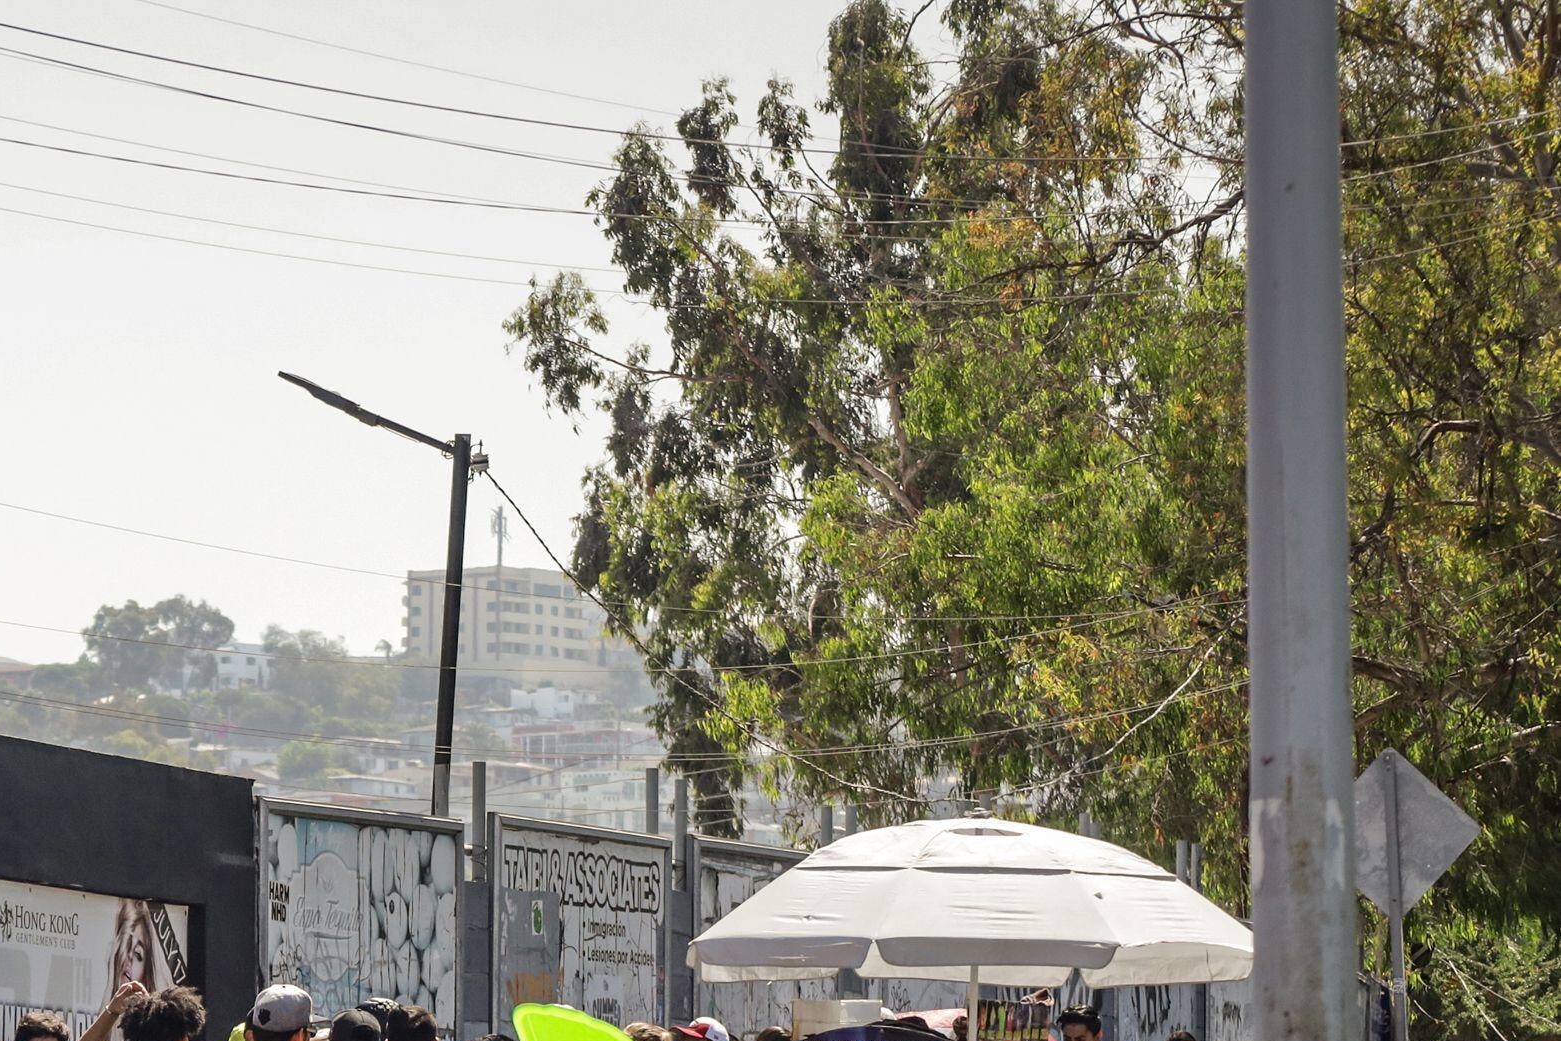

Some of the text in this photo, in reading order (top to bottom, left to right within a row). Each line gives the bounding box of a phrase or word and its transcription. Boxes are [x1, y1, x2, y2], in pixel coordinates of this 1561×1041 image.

[504, 844, 550, 892] TAIBI
[561, 852, 661, 915] ASSOCIATES
[153, 908, 186, 984] JULY 17
[588, 946, 616, 962] Lesiones
[618, 951, 628, 966] por
